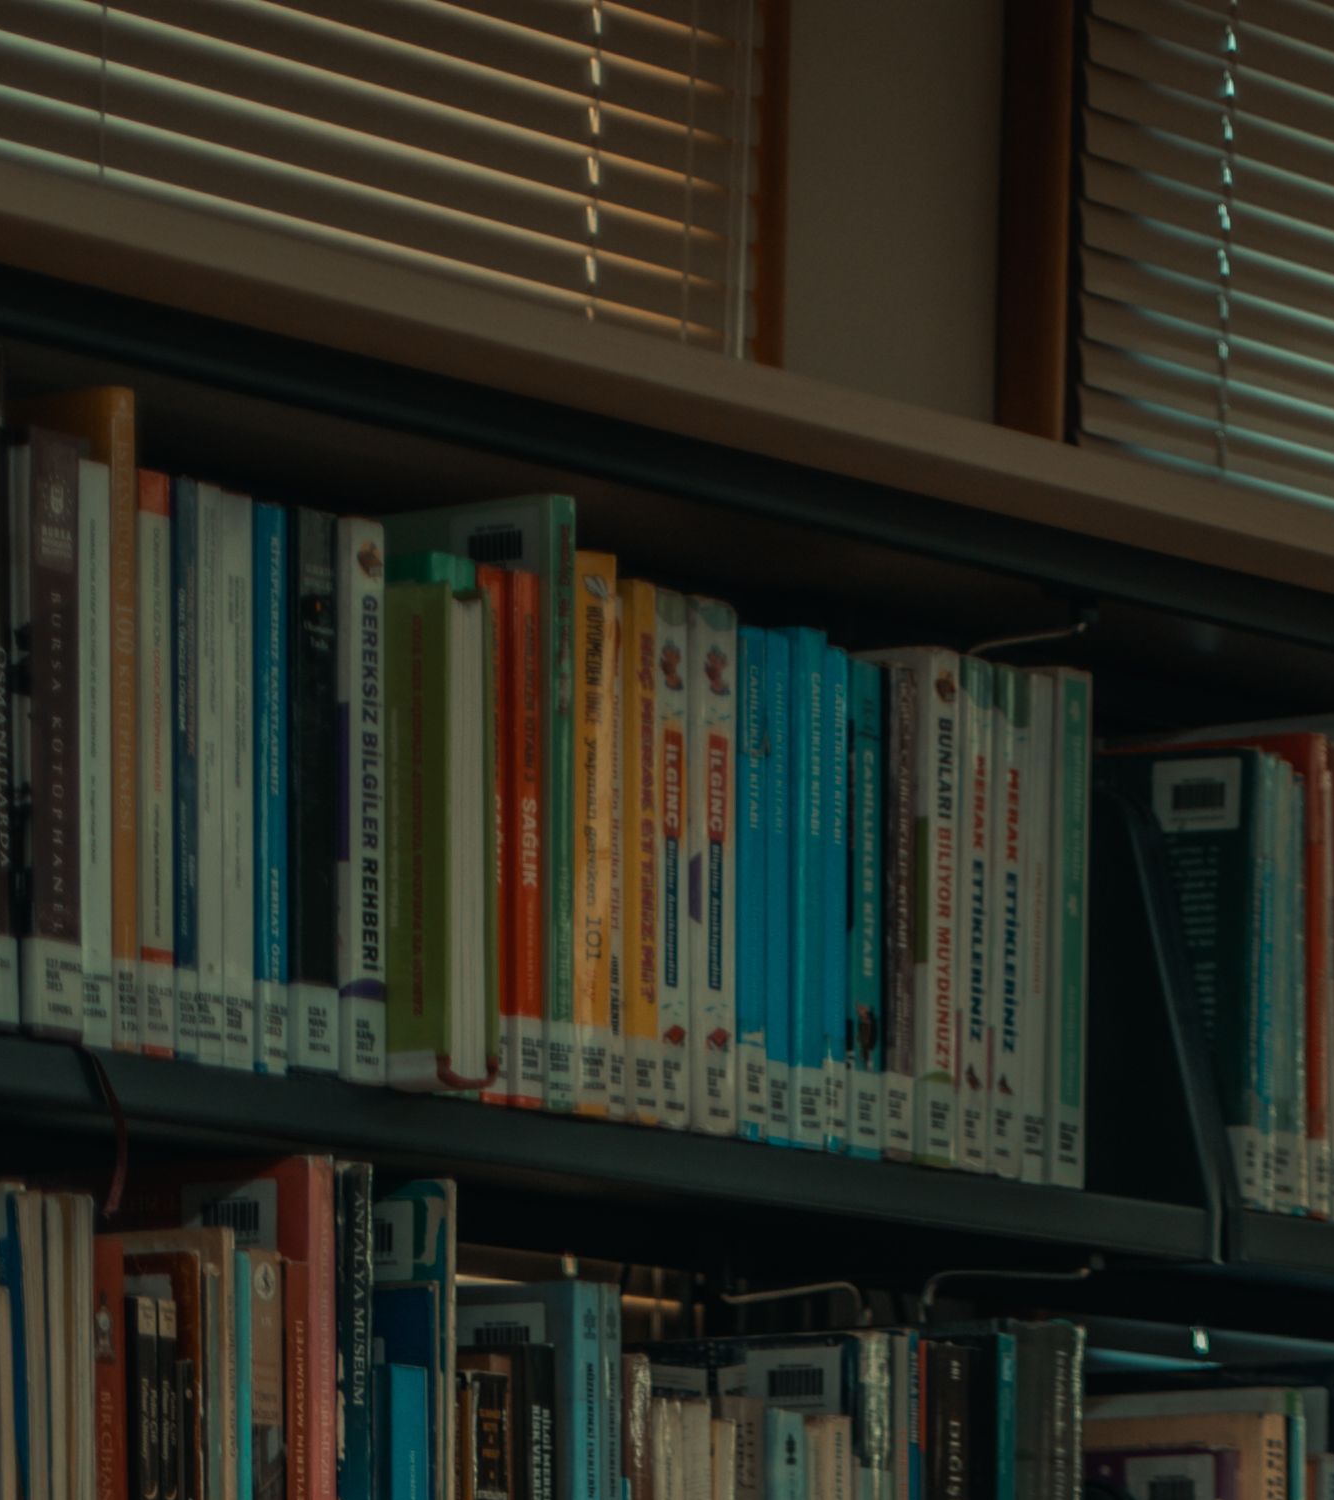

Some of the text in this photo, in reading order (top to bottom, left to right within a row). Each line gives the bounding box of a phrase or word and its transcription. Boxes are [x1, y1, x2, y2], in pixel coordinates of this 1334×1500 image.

[361, 595, 383, 972] GEREKSİZ BİLGİLER REHBERİ
[937, 718, 955, 820] BUNLARI
[936, 826, 955, 919] BİLİYOR
[1001, 871, 1019, 1053] ETTİKLERİNİZ
[349, 1192, 367, 1406] ANTALYA MUSEUM
